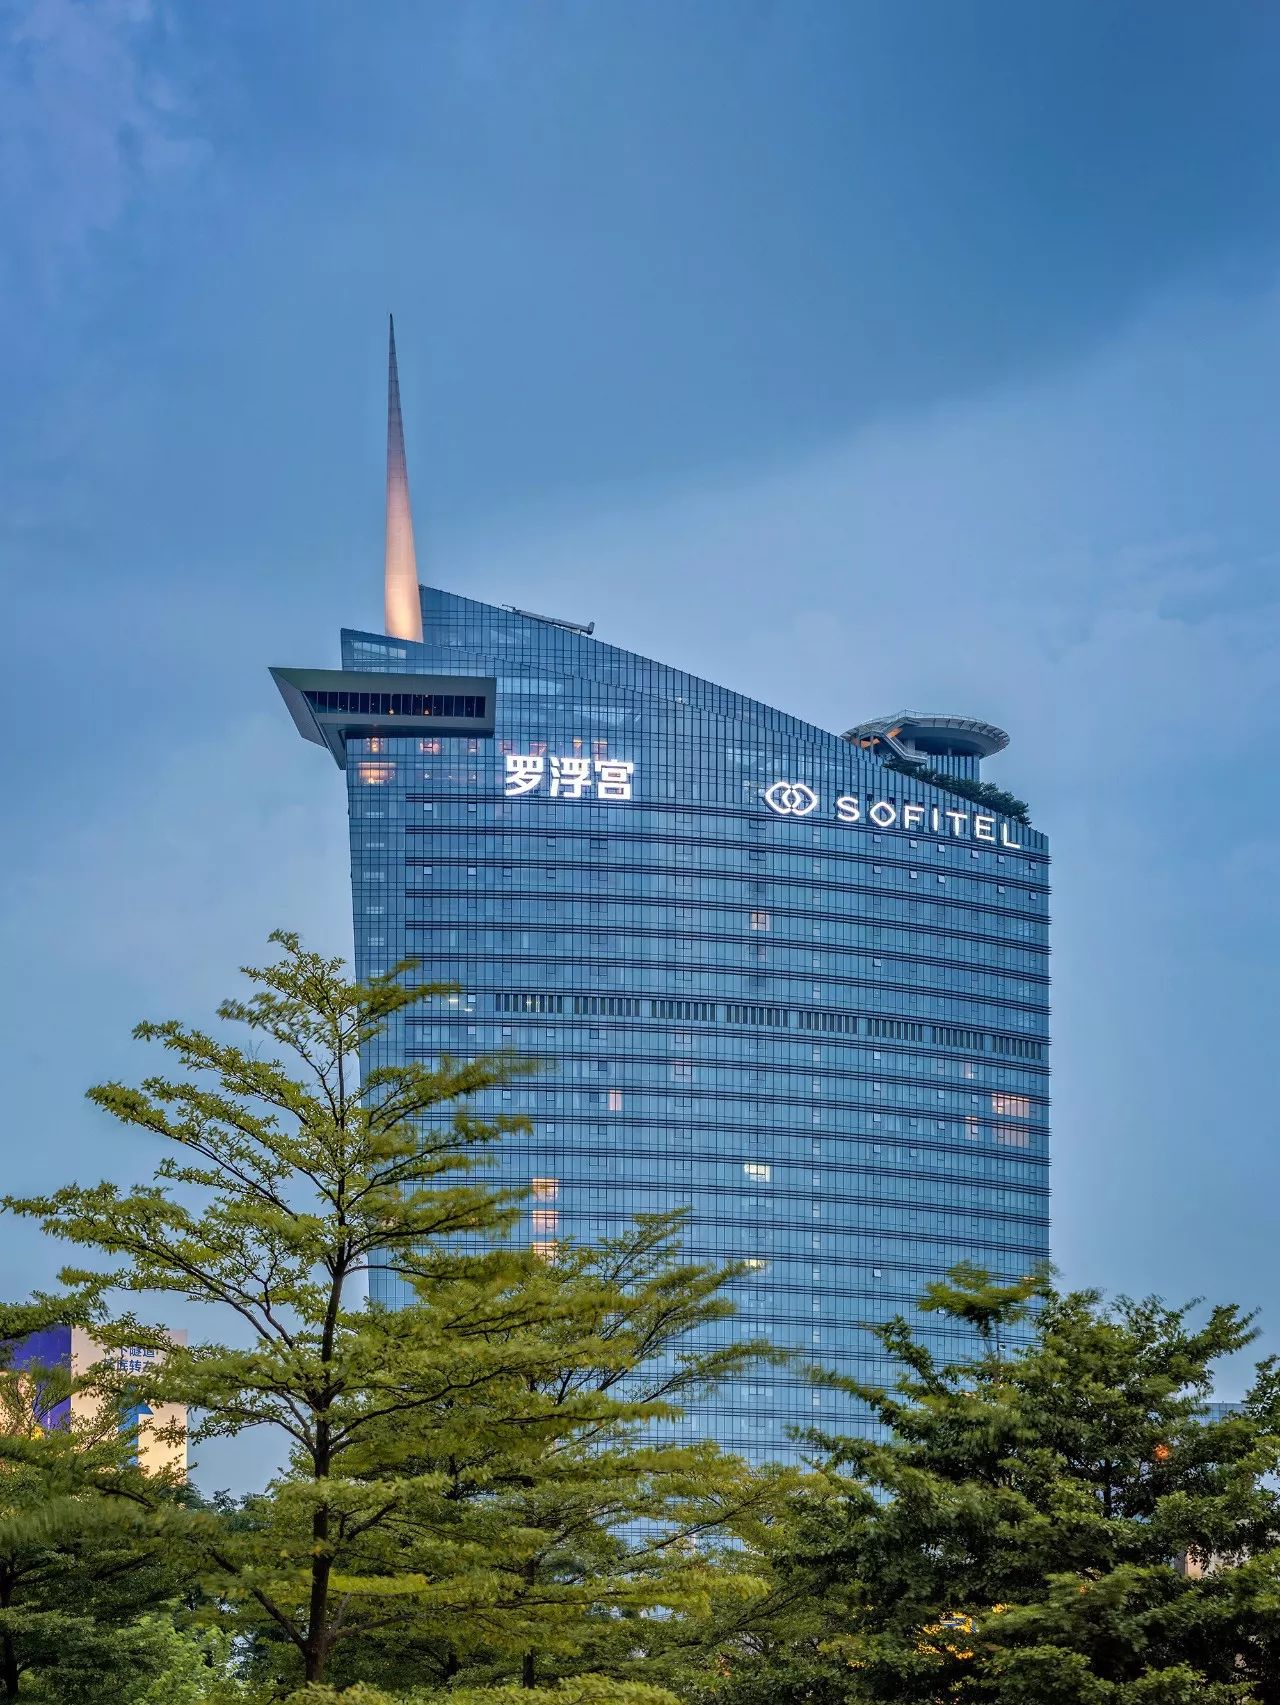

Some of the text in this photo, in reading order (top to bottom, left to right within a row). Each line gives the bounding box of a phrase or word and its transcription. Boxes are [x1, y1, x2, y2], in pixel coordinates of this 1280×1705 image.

[504, 754, 634, 800] 罗浮宫
[835, 795, 1021, 849] SOFITEL
